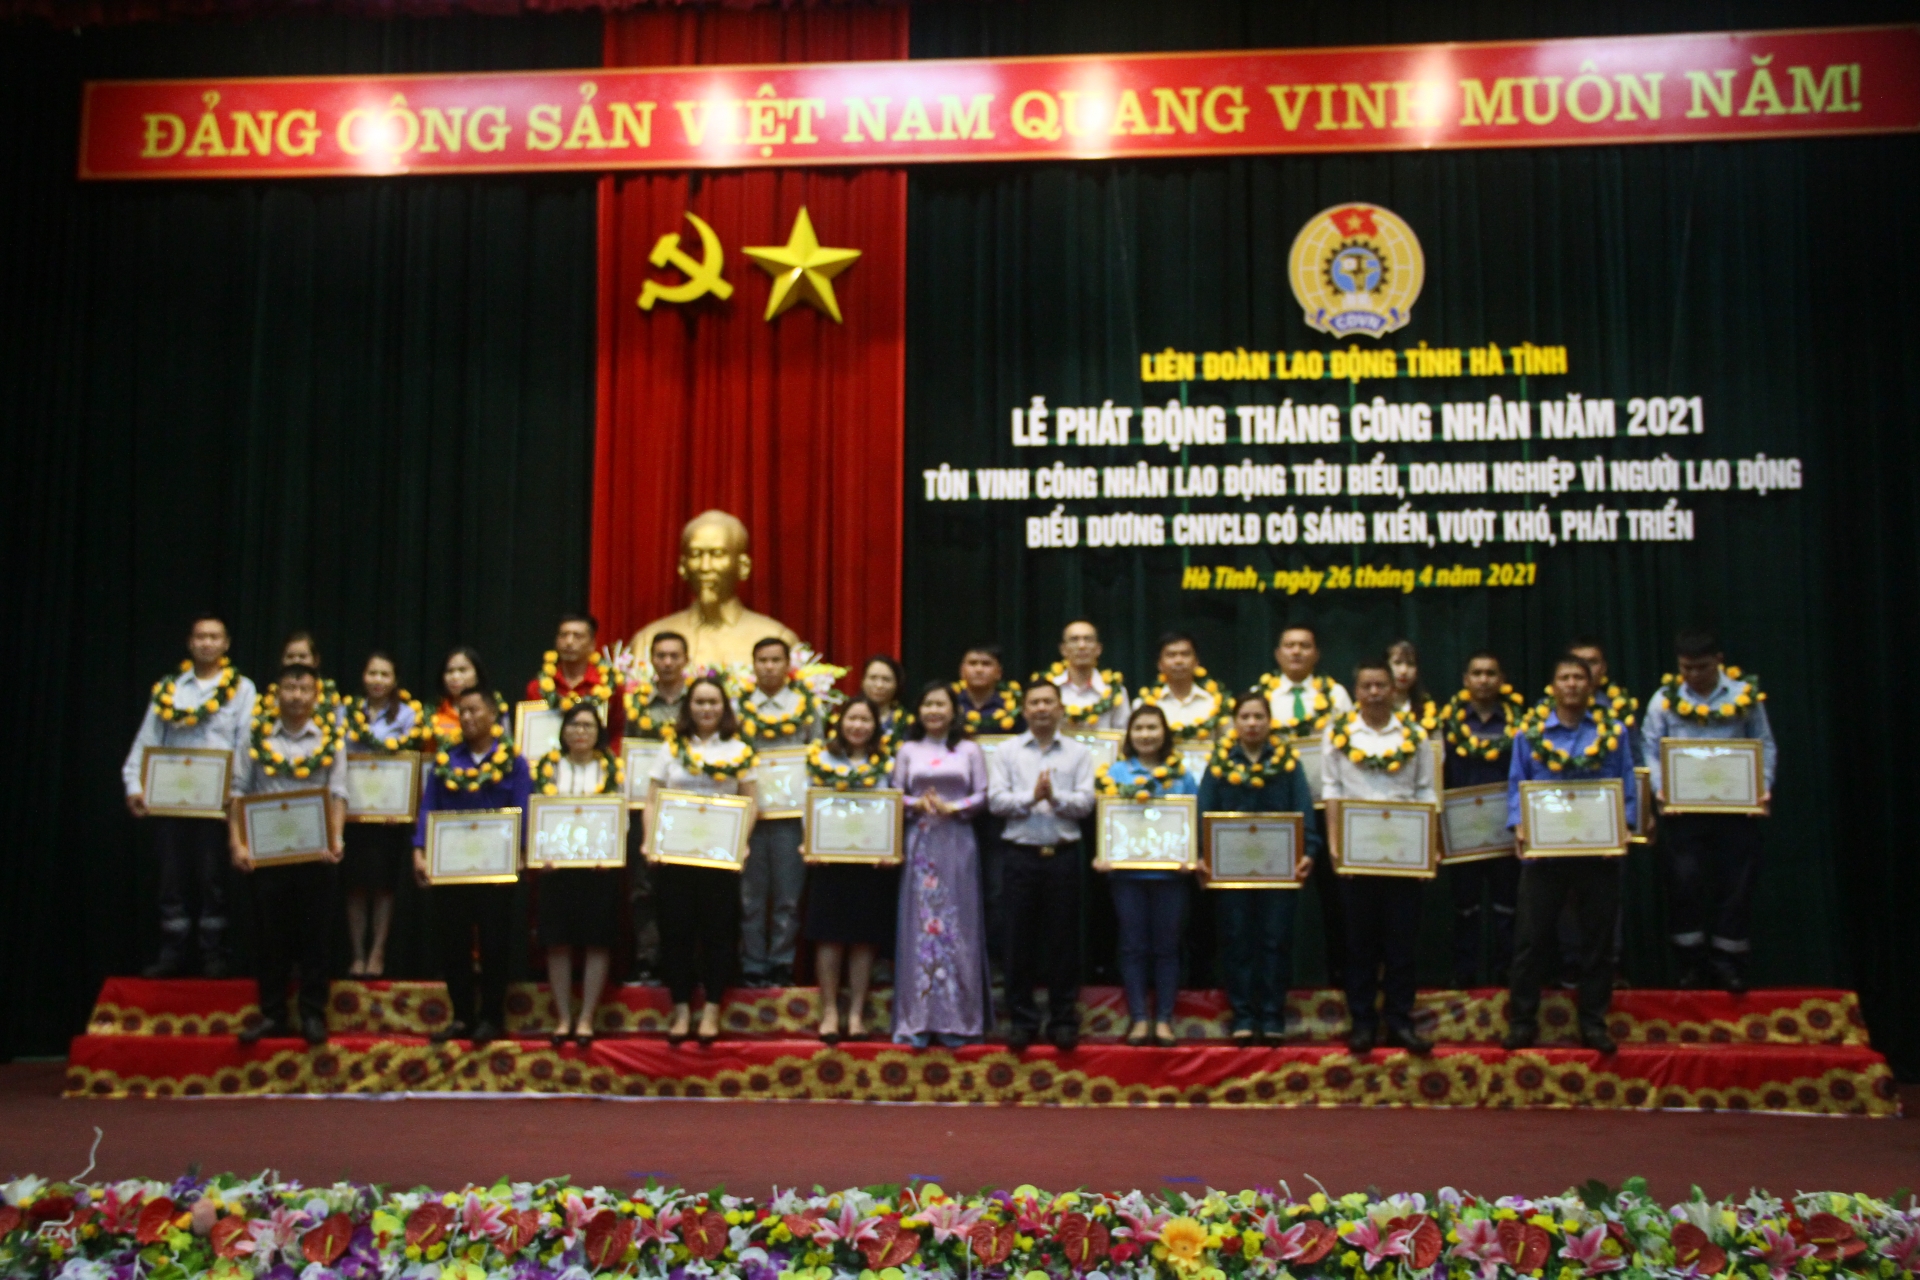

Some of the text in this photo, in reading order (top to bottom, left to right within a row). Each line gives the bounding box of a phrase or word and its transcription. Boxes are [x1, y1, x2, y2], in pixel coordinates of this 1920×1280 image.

[141, 53, 1862, 165] ĐẢNG CỘNG SẢN VIỆT NAM QUANG VINH MUÔN NĂM!
[1140, 347, 1196, 382] LIÊN
[1203, 347, 1271, 380] ĐOÀN
[1276, 350, 1324, 380] LAO
[1330, 344, 1398, 384] ĐỘNG
[1404, 340, 1462, 377] TỈNH
[1469, 341, 1505, 375] HÀ
[1011, 392, 1704, 452] LỄ PHÁT ĐỘNG THÁNG CÔNG NHÂN NĂM 2021
[923, 452, 1802, 502] TÔN VINH CÔNG NHÂN LAO ĐỘNG TIÊU BIỂU, DOANH NGHIỆP VÌ NGƯỜI LAO ĐỘNG
[1026, 497, 1695, 549] BIỂU DƯƠNG CNVCLĐ CÓ SÁNG KIẾN, VƯỢT KHÓ, PHÁT TRIỂN
[1182, 565, 1211, 590] Hà
[1273, 566, 1325, 595] ngày
[1326, 565, 1352, 589] 26
[1354, 564, 1415, 594] tháng
[1418, 564, 1434, 586] 4
[1435, 564, 1482, 586] năm
[1486, 562, 1537, 586] 2021
